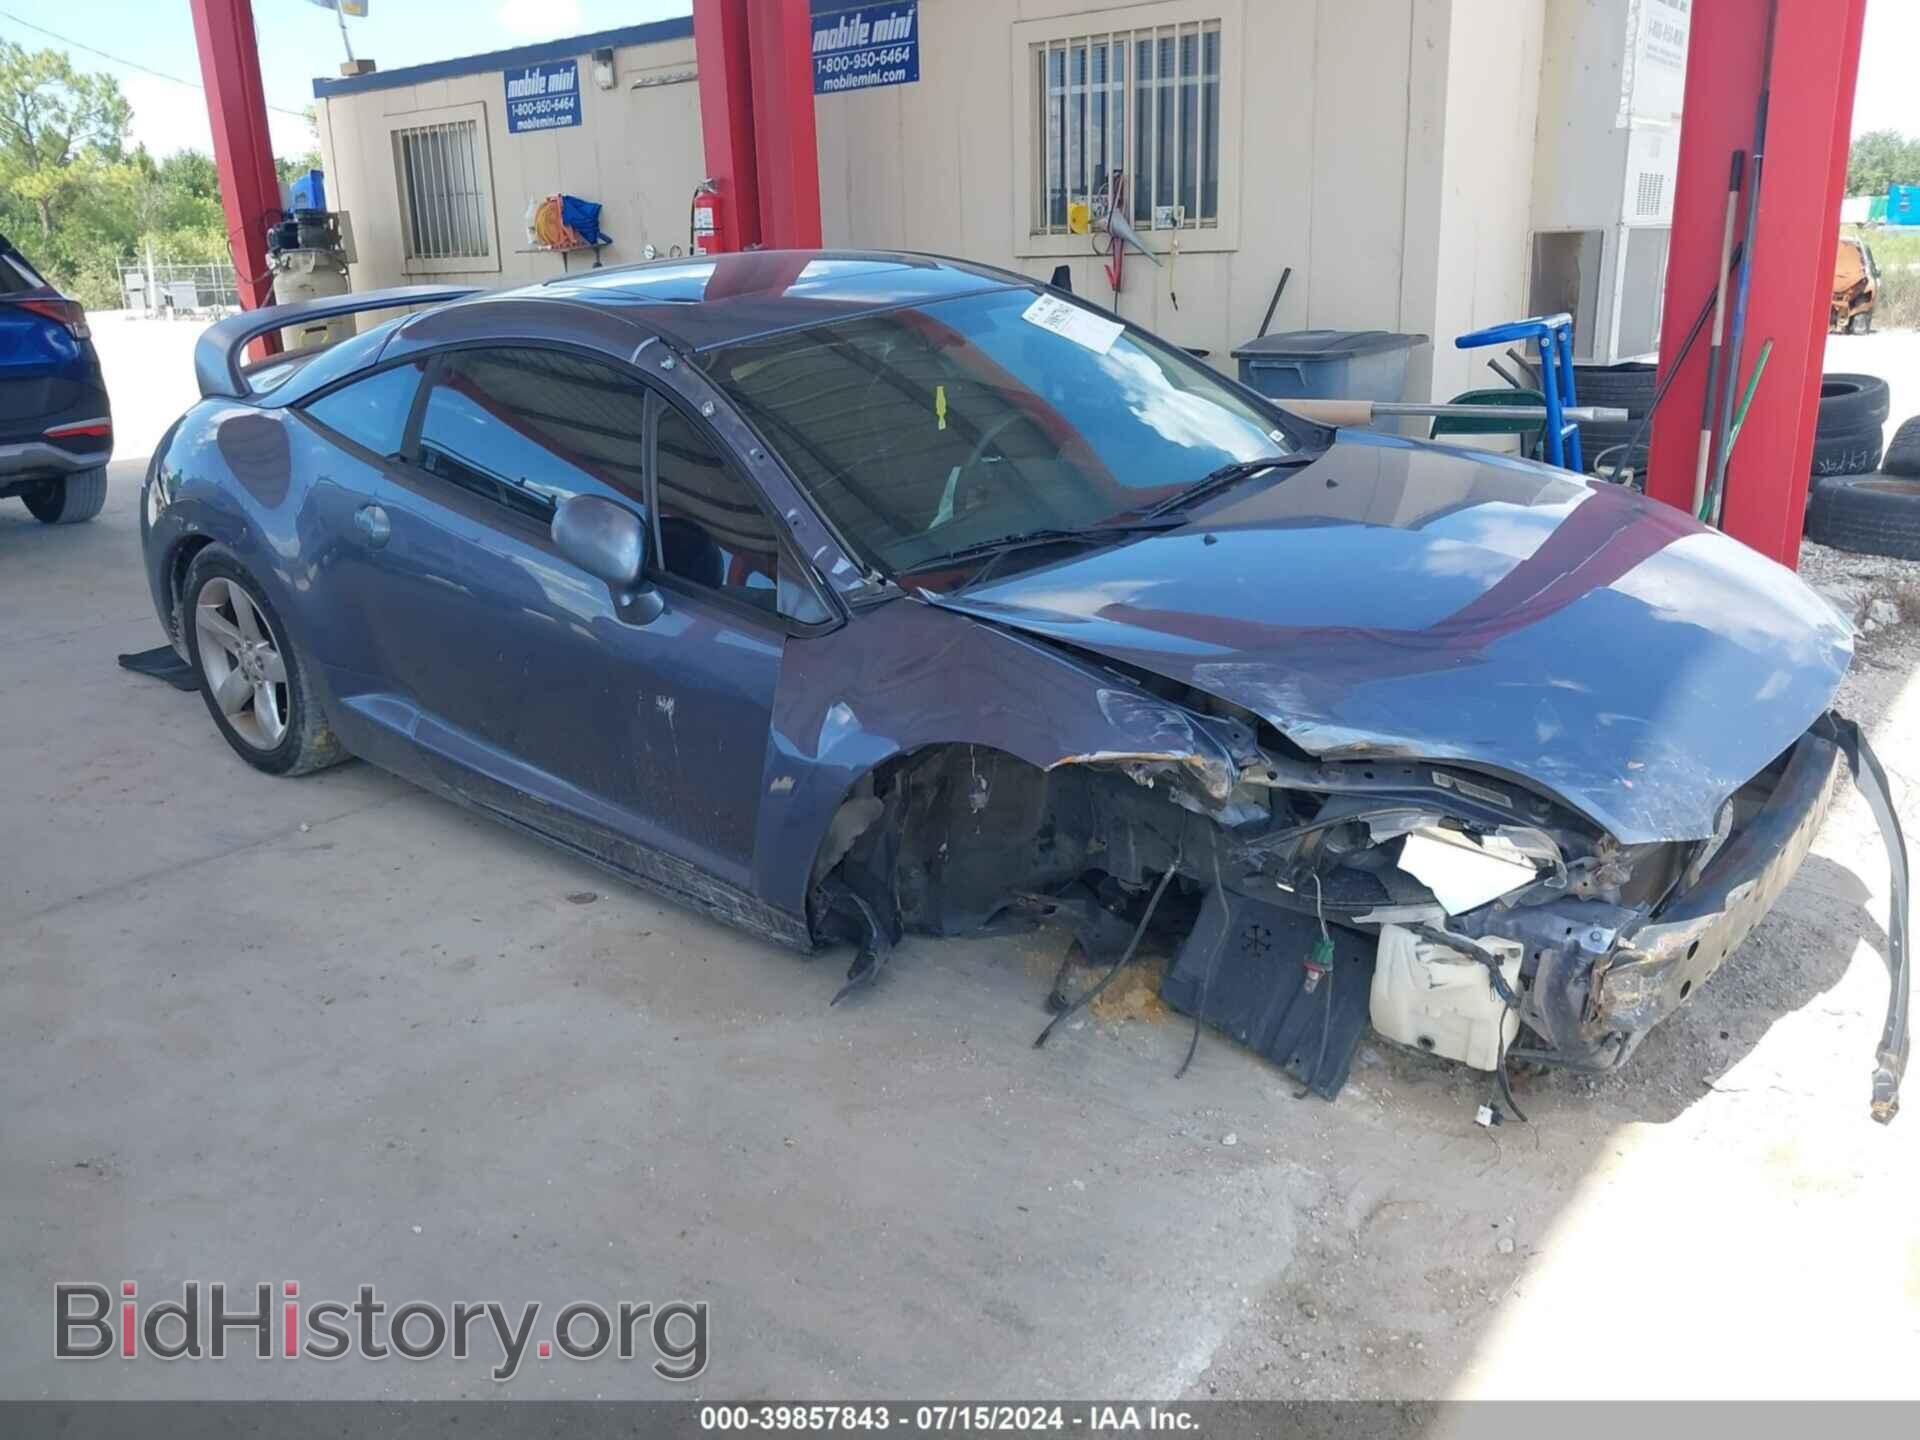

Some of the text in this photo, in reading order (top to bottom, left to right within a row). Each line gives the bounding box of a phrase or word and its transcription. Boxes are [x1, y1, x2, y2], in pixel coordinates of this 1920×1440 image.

[812, 8, 914, 52] mobile mini
[817, 45, 910, 75] 1-800-950-6464
[507, 65, 576, 99] mobile mini
[823, 68, 906, 91] mobilemini.com
[511, 96, 574, 117] 1-800-950-6464
[517, 114, 573, 130] mobilemini.com
